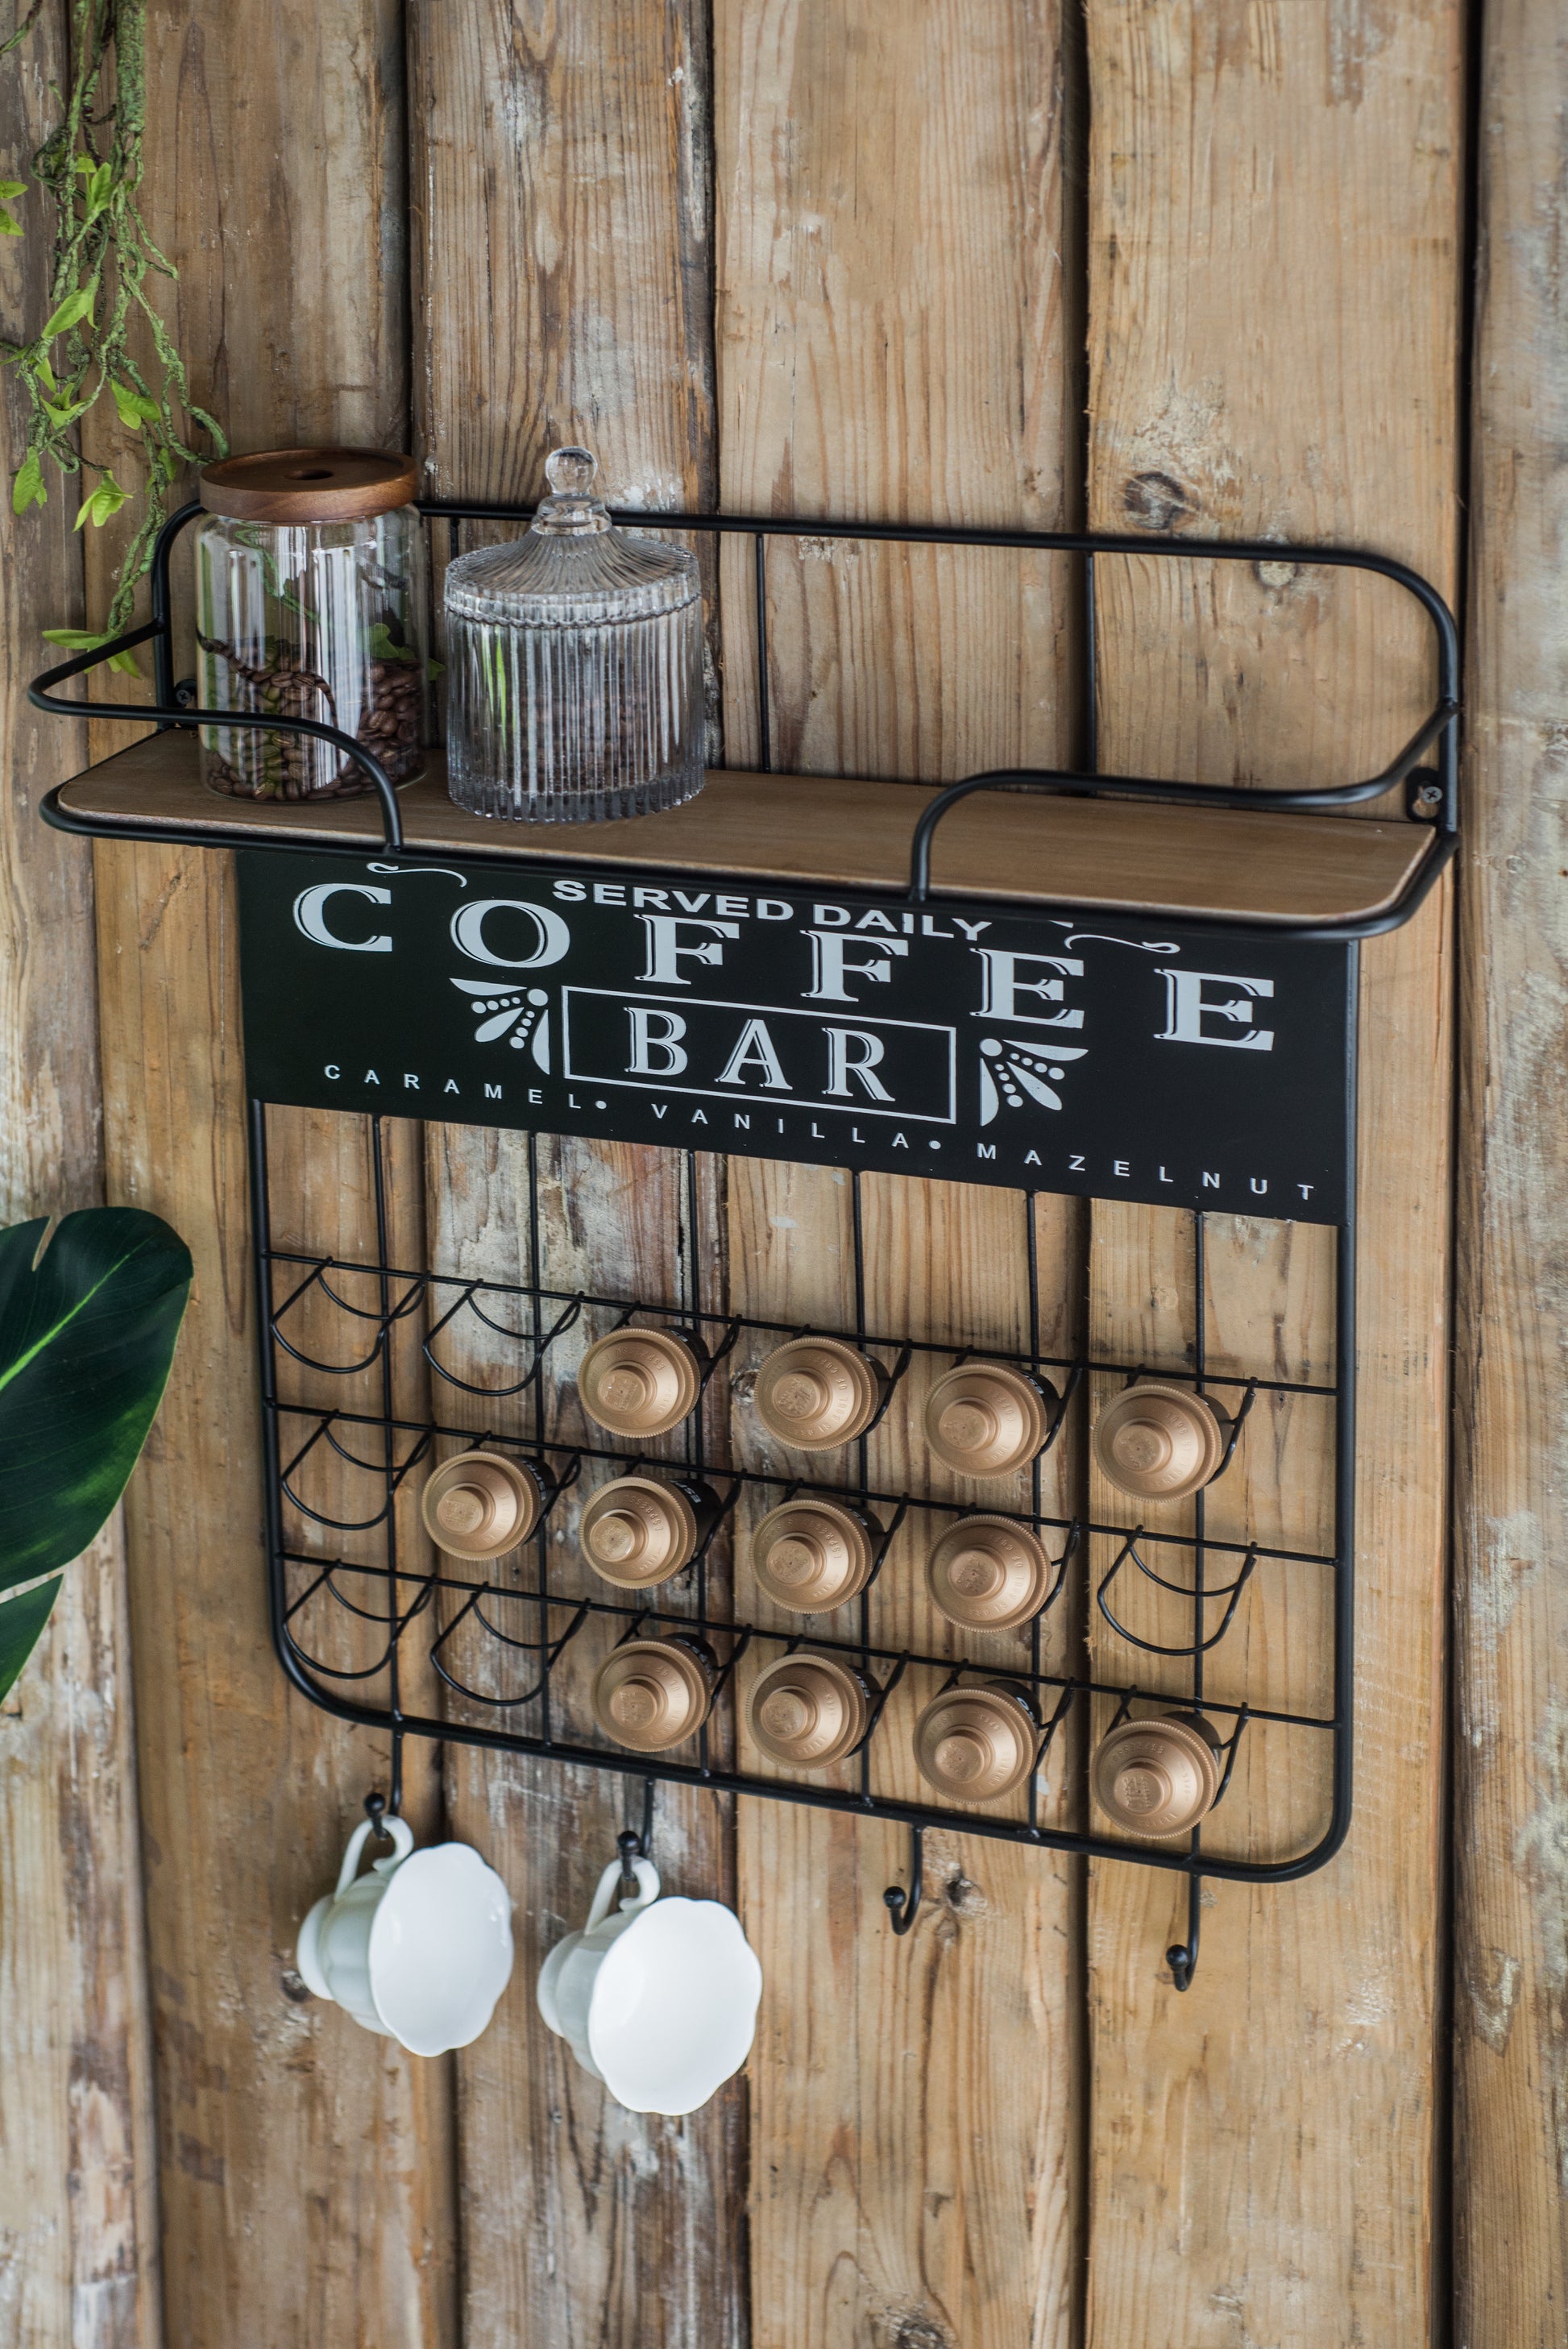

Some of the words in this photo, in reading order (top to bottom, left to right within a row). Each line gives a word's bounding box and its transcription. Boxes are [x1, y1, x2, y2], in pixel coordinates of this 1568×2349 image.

[292, 882, 1276, 1052] COFFEE
[553, 879, 793, 921] SERVED
[813, 903, 992, 941] DAILY
[624, 1006, 896, 1102] BAR
[324, 1065, 582, 1110] CARAMEL
[651, 1103, 910, 1148] VANILLA
[977, 1142, 1315, 1200] MAZELNUT
